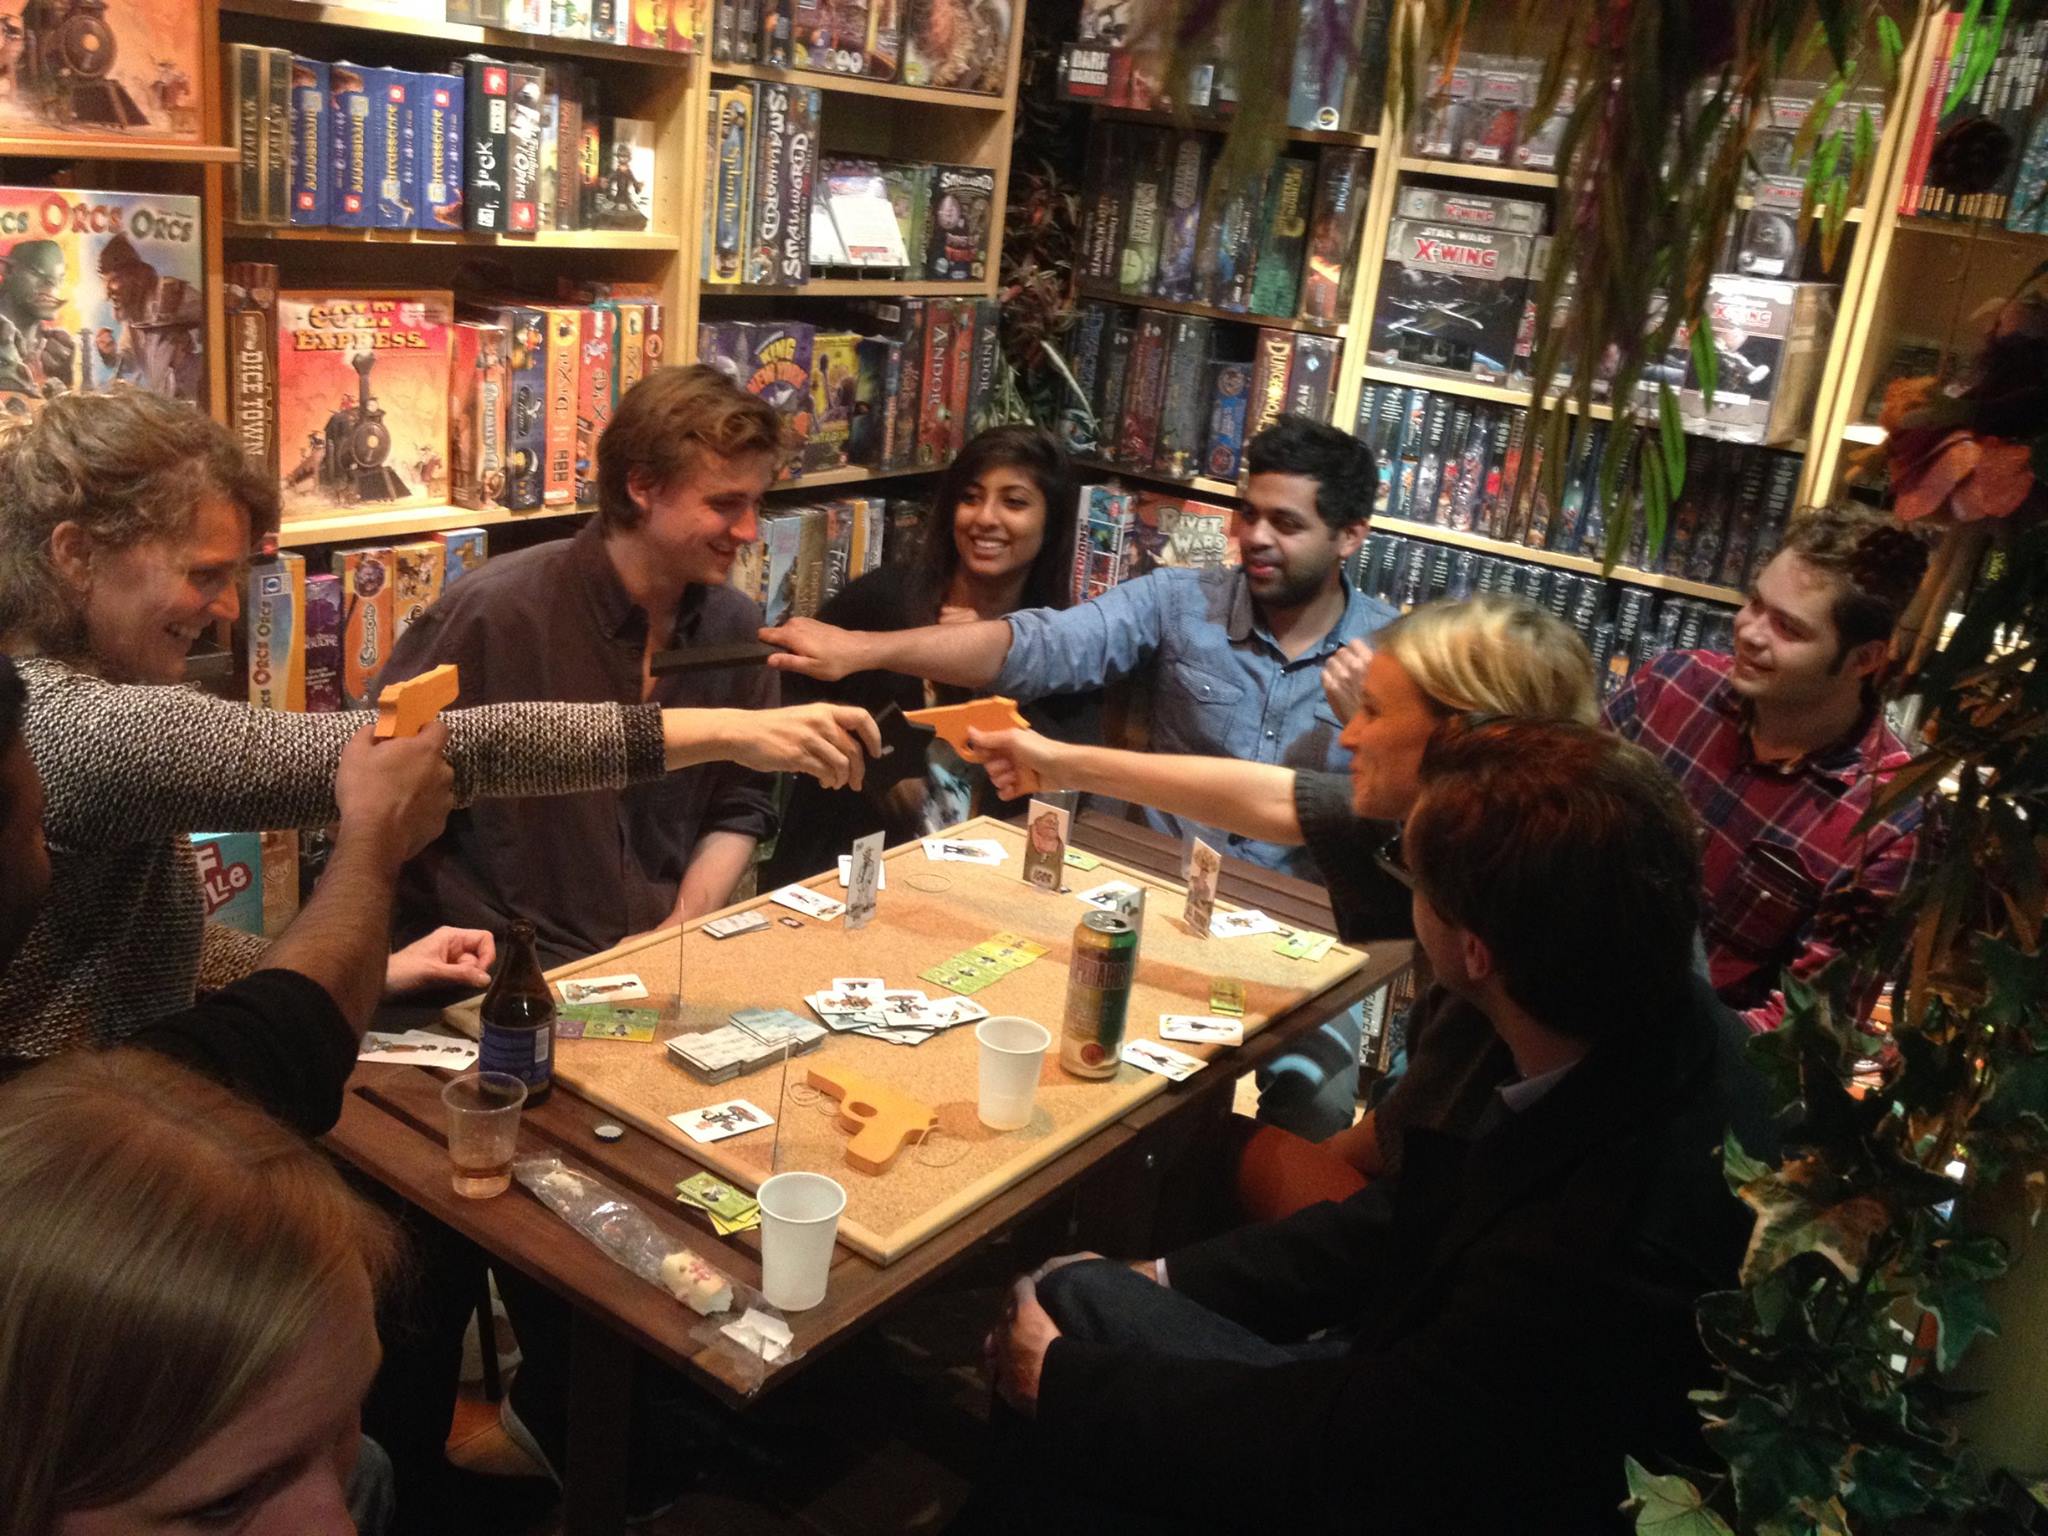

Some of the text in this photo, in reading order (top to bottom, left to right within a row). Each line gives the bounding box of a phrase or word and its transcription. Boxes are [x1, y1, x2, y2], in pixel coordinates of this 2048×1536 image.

[40, 193, 124, 235] ORCS
[131, 209, 194, 242] ORCS
[1408, 236, 1500, 269] X-WING
[294, 331, 430, 351] EXPRESS
[242, 350, 264, 394] DICE
[243, 397, 265, 457] TOWN
[1158, 505, 1226, 534] RIVET
[1172, 531, 1229, 554] WARS
